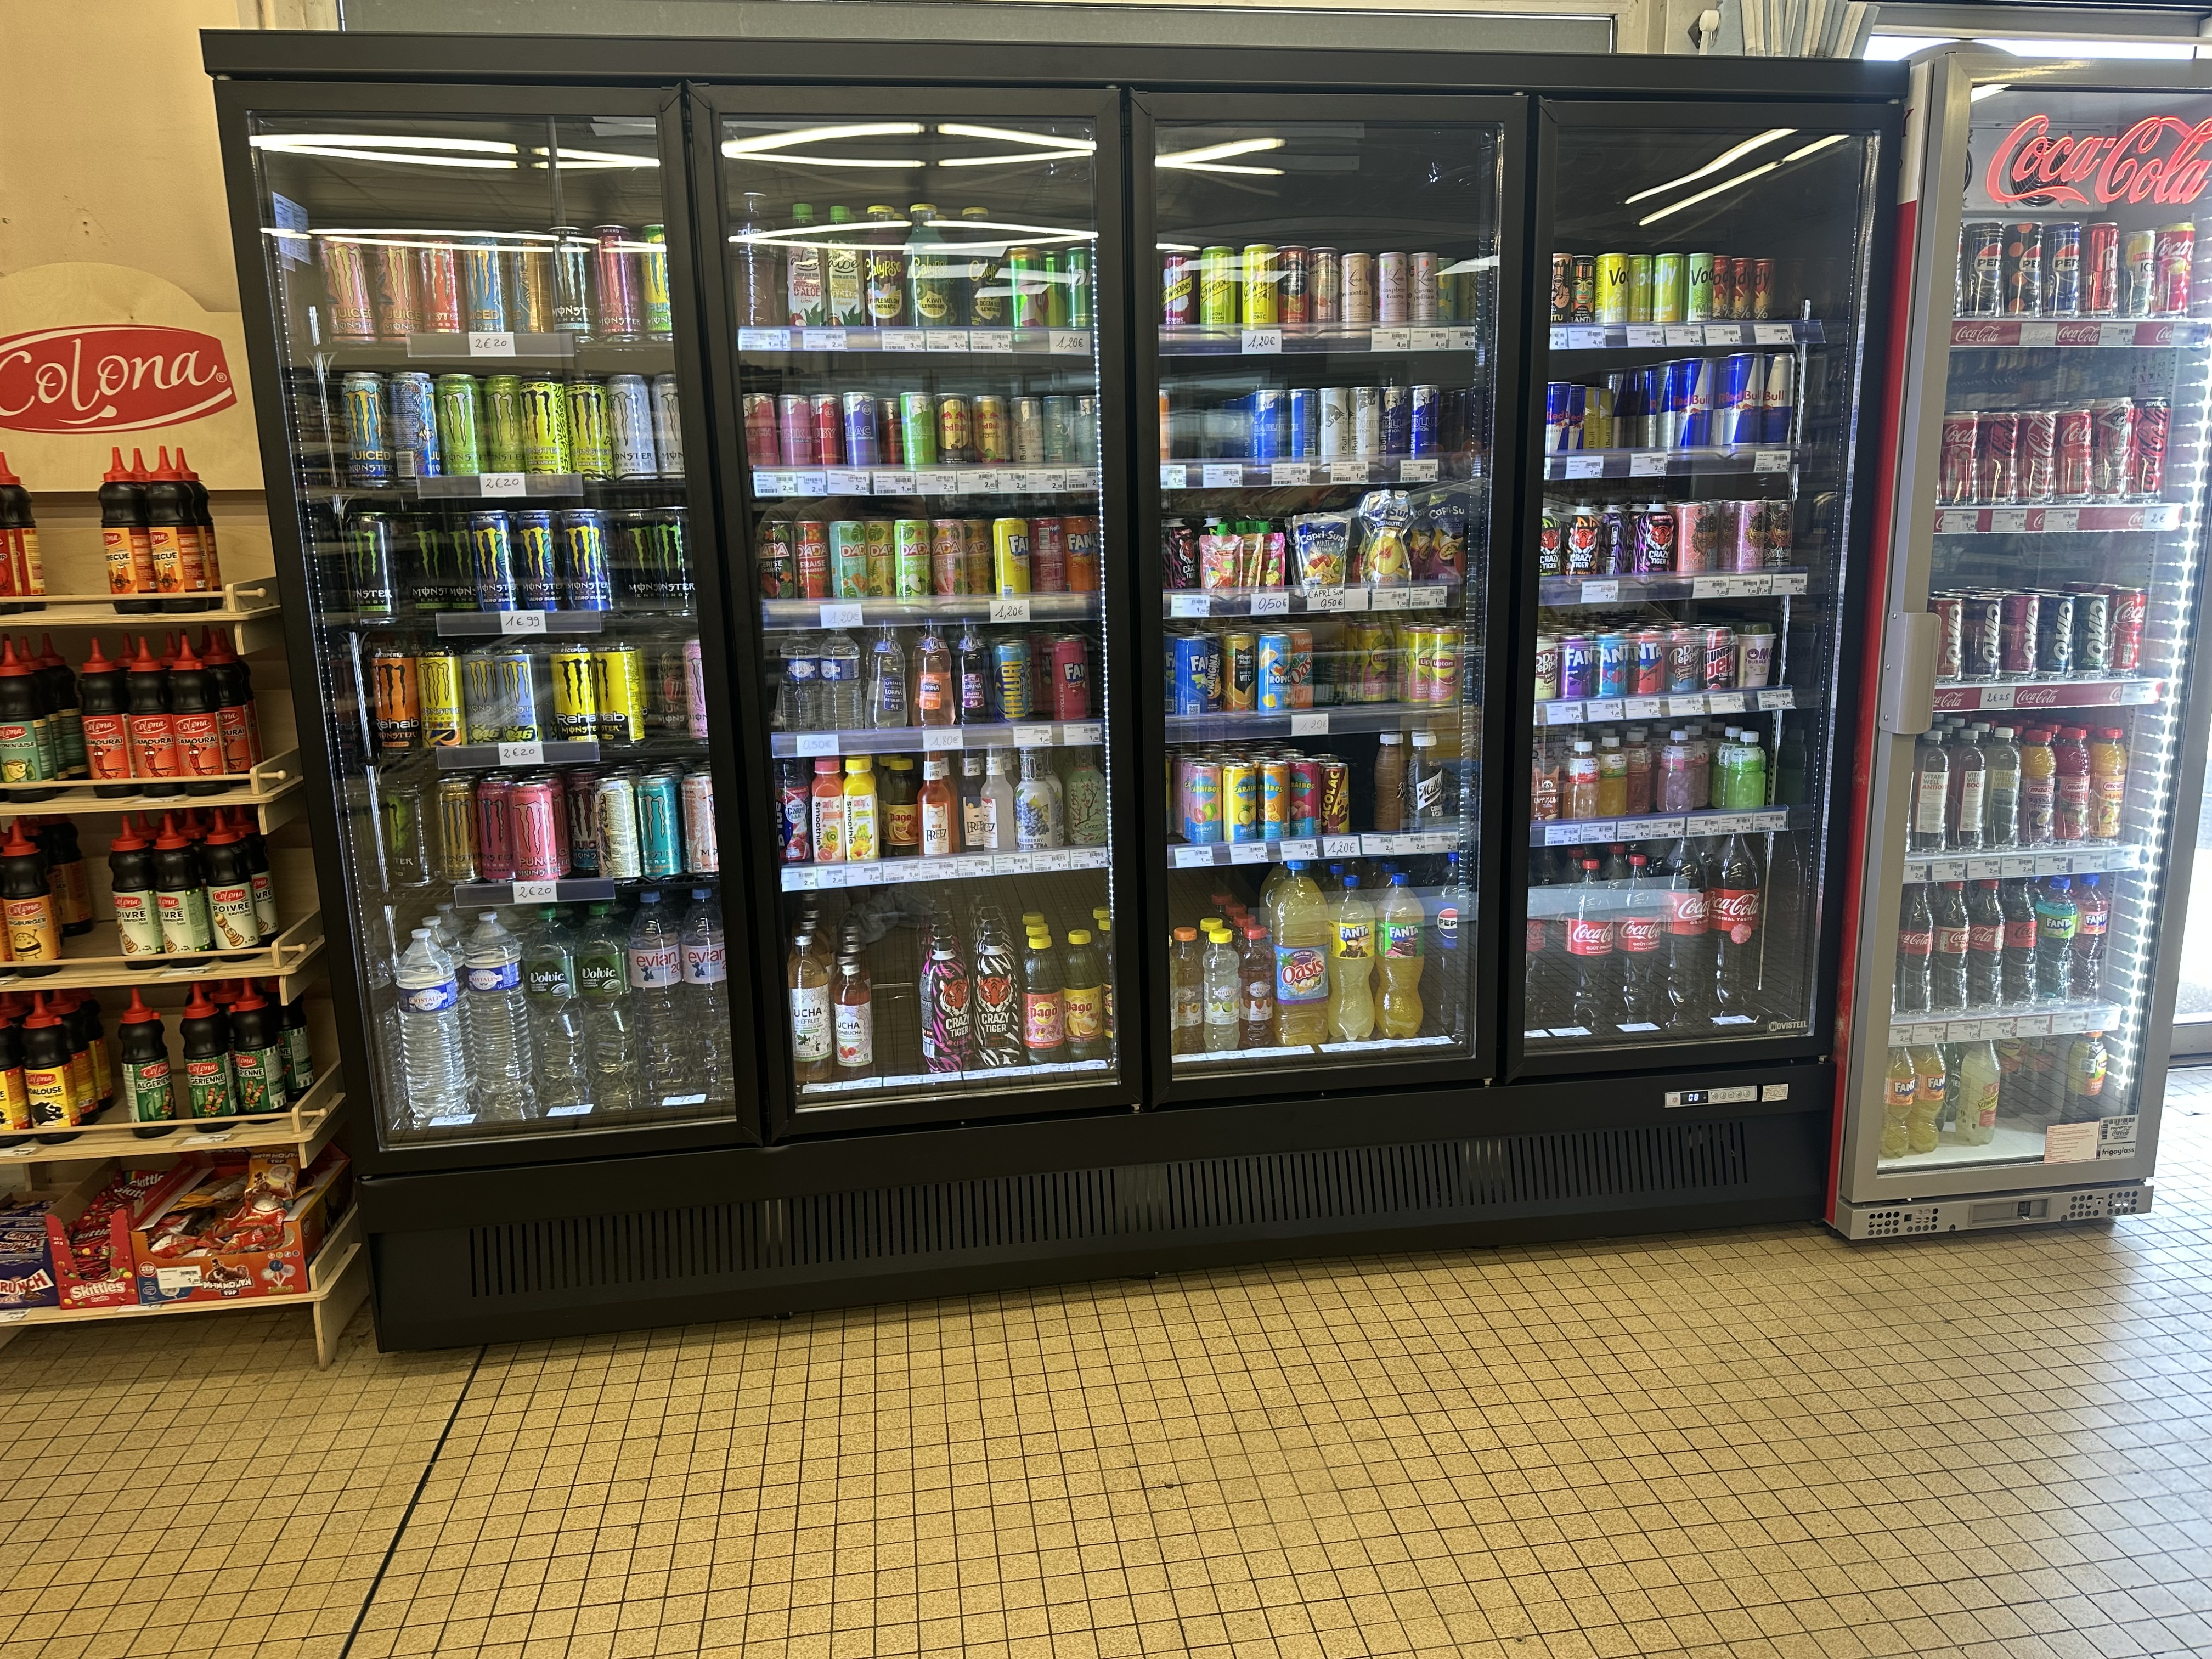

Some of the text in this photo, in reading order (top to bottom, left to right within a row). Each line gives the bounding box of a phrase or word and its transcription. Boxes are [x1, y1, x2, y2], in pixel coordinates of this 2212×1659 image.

[1986, 114, 2212, 204] Coca-Cola
[649, 304, 670, 313] PUN
[386, 310, 421, 320] JUICE
[1955, 326, 2001, 342] Coca-Cola
[2057, 326, 2100, 342] Coca-Cola
[0, 338, 217, 416] Colona
[350, 450, 391, 460] JUICED
[1429, 505, 1464, 518] Capri-Su
[1570, 554, 1593, 562] CRAZY
[1648, 550, 1669, 558] CRAZY
[1308, 590, 1330, 599] CAPRI
[2017, 689, 2059, 705] Coca-Cola
[134, 720, 165, 730] Colona
[178, 720, 209, 730] Colona
[515, 730, 533, 739] 46
[177, 736, 217, 745] SAMOURAI
[520, 857, 556, 866] PUNCH
[213, 890, 245, 901] Colona
[8, 903, 41, 916] Colona
[213, 902, 250, 913] POIVRE
[117, 910, 146, 918] OIVRE
[1340, 926, 1369, 937] FANTA
[1389, 926, 1418, 938] FANTA
[637, 951, 678, 967] evian
[689, 949, 725, 963] evian
[531, 972, 564, 982] Volvic
[582, 968, 616, 978] Volvic
[1282, 958, 1324, 985] Oasis
[794, 1008, 822, 1017] UCHA
[981, 1012, 1009, 1024] CRAZY
[838, 1021, 859, 1029] UCHA
[946, 1015, 969, 1028] CRAZY
[1769, 1020, 1808, 1032] NOVISTEEL
[950, 1026, 968, 1037] TIGER
[986, 1023, 1006, 1032] TIGER
[2102, 1147, 2135, 1156] frigoglass
[71, 1282, 126, 1300] Skittles
